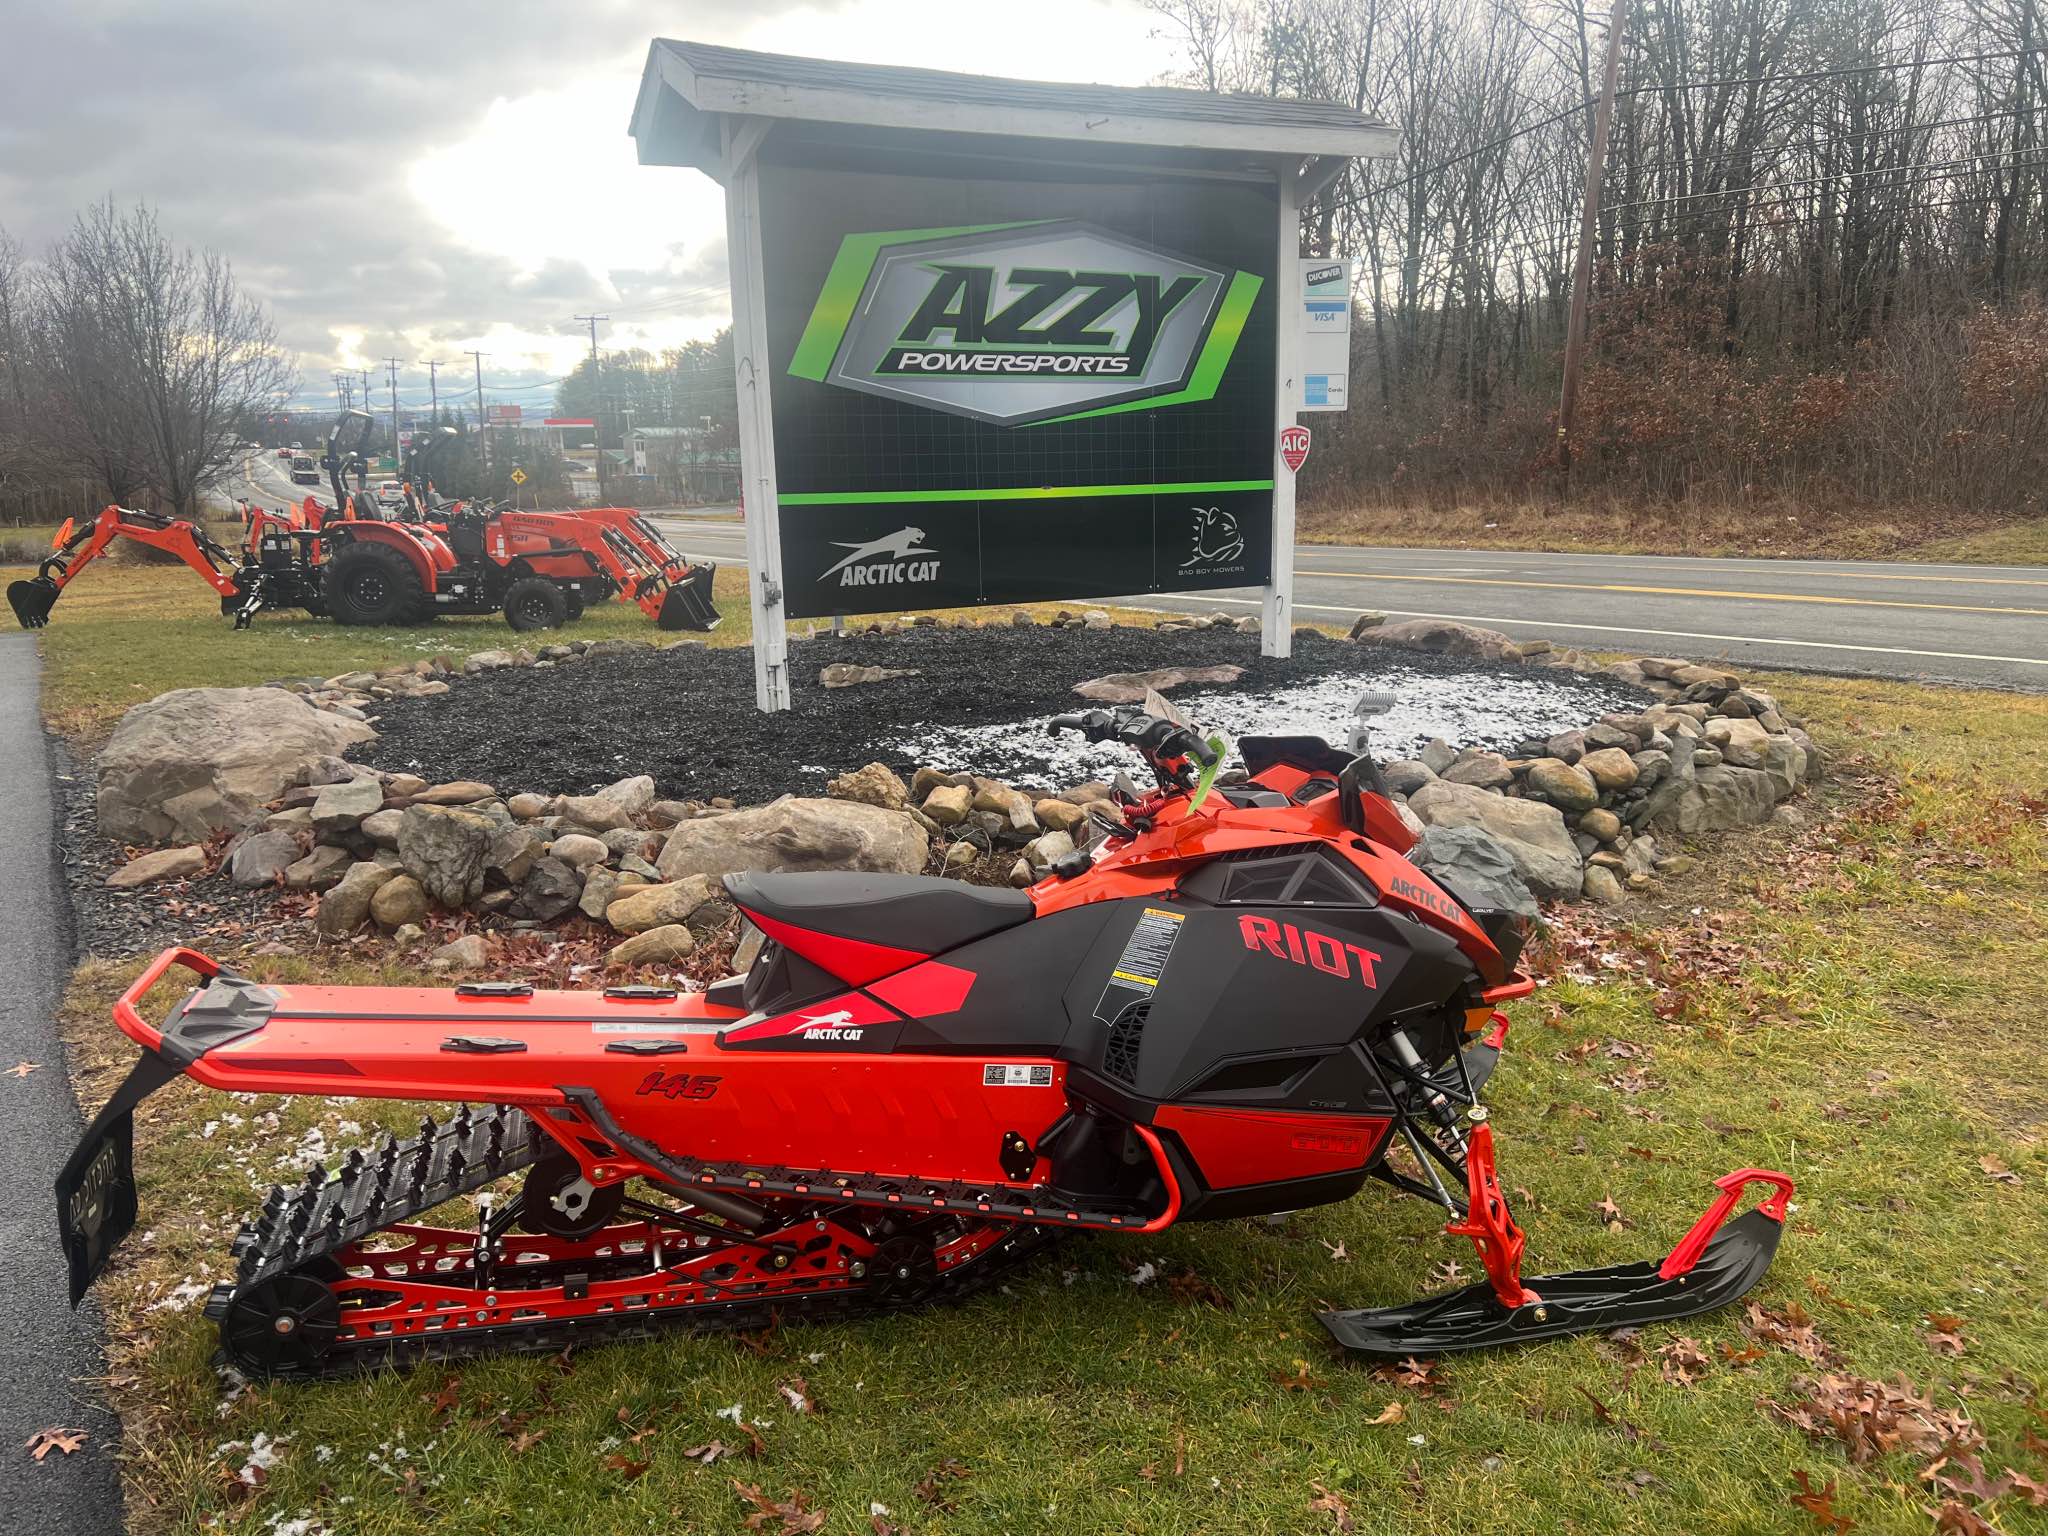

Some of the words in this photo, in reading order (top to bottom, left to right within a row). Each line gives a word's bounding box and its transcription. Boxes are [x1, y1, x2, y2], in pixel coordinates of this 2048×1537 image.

[896, 263, 1207, 375] AZZY
[1314, 313, 1336, 321] VISA
[897, 350, 1131, 374] POWERSPORTS
[1282, 436, 1308, 452] AIC
[839, 564, 904, 588] ARCTIC
[905, 560, 941, 584] CAT
[1213, 566, 1245, 574] MOWERS
[1391, 876, 1438, 910] ARCTIC
[1439, 898, 1463, 923] CAT
[1238, 913, 1383, 990] RIOT
[803, 1029, 840, 1041] ARCTIC
[841, 1029, 864, 1041] CAT
[635, 1071, 723, 1100] 146
